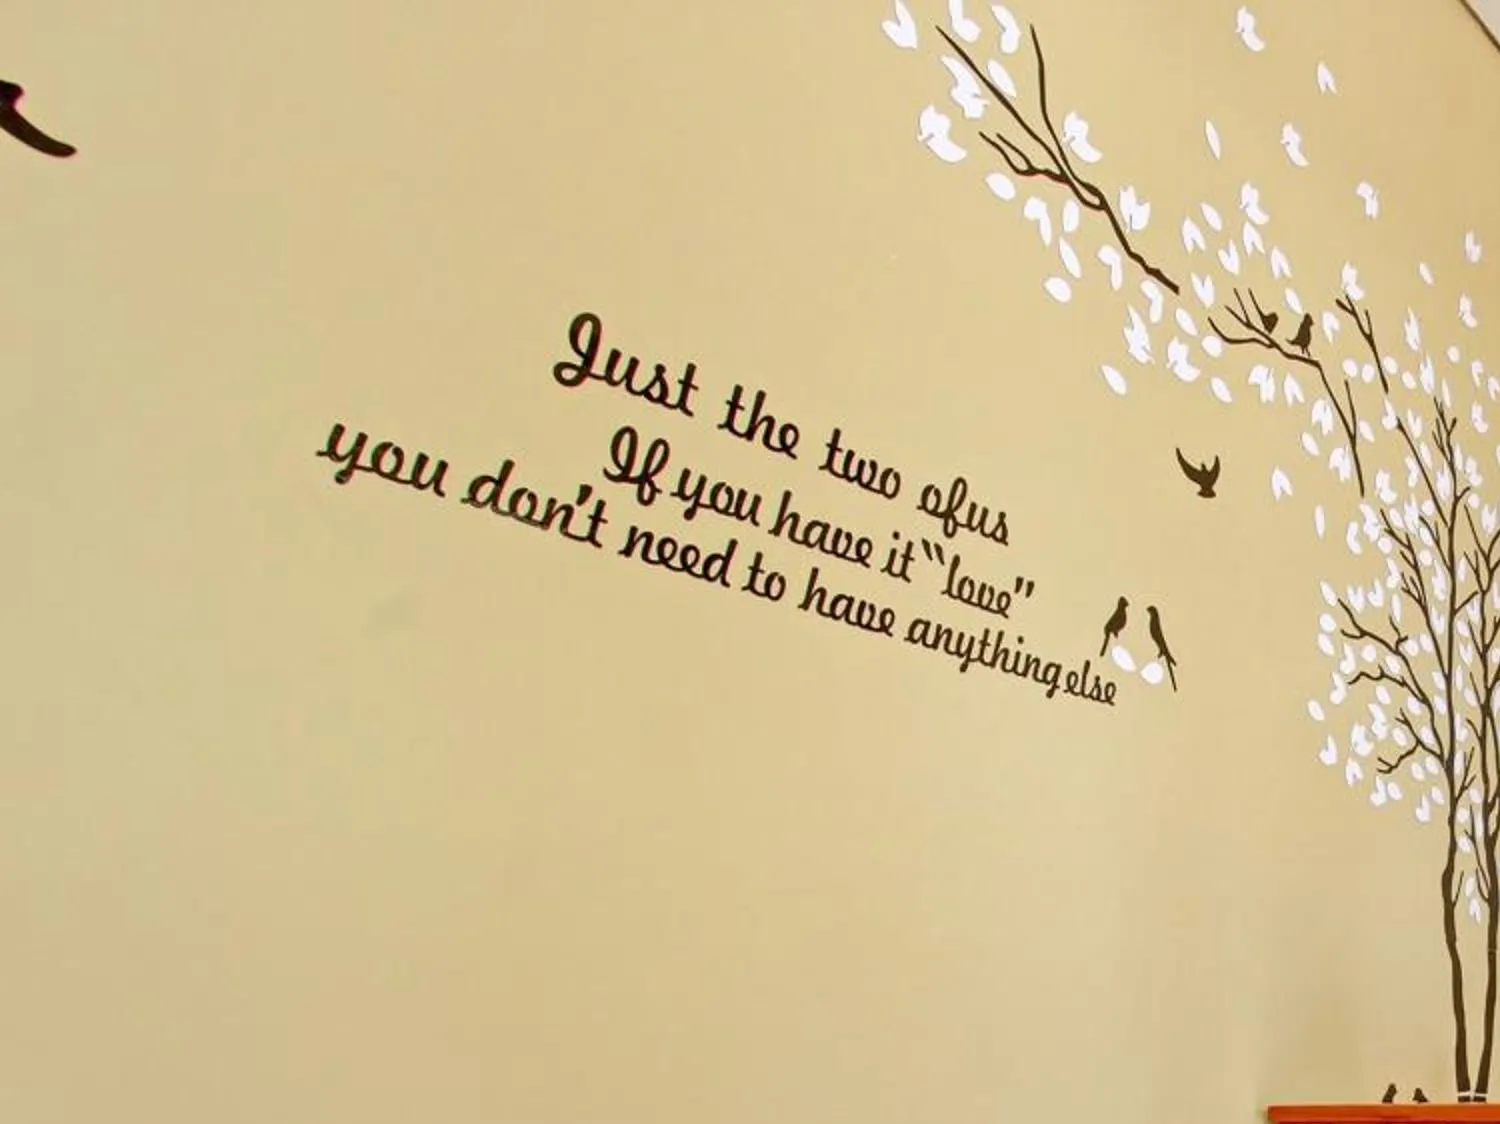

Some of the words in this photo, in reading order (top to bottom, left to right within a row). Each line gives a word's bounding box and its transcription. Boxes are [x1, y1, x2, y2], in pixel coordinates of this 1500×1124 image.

[552, 311, 700, 418] Just
[716, 383, 801, 461] the
[817, 427, 902, 501] two
[315, 422, 449, 499] you
[459, 458, 609, 550] don't
[616, 525, 739, 589] need
[740, 551, 787, 603] to
[796, 566, 896, 638] have
[903, 617, 1063, 700] anything
[1062, 659, 1117, 707] else
[602, 425, 671, 508] If
[670, 467, 763, 528] you
[767, 489, 874, 569] have
[879, 530, 916, 584] it
